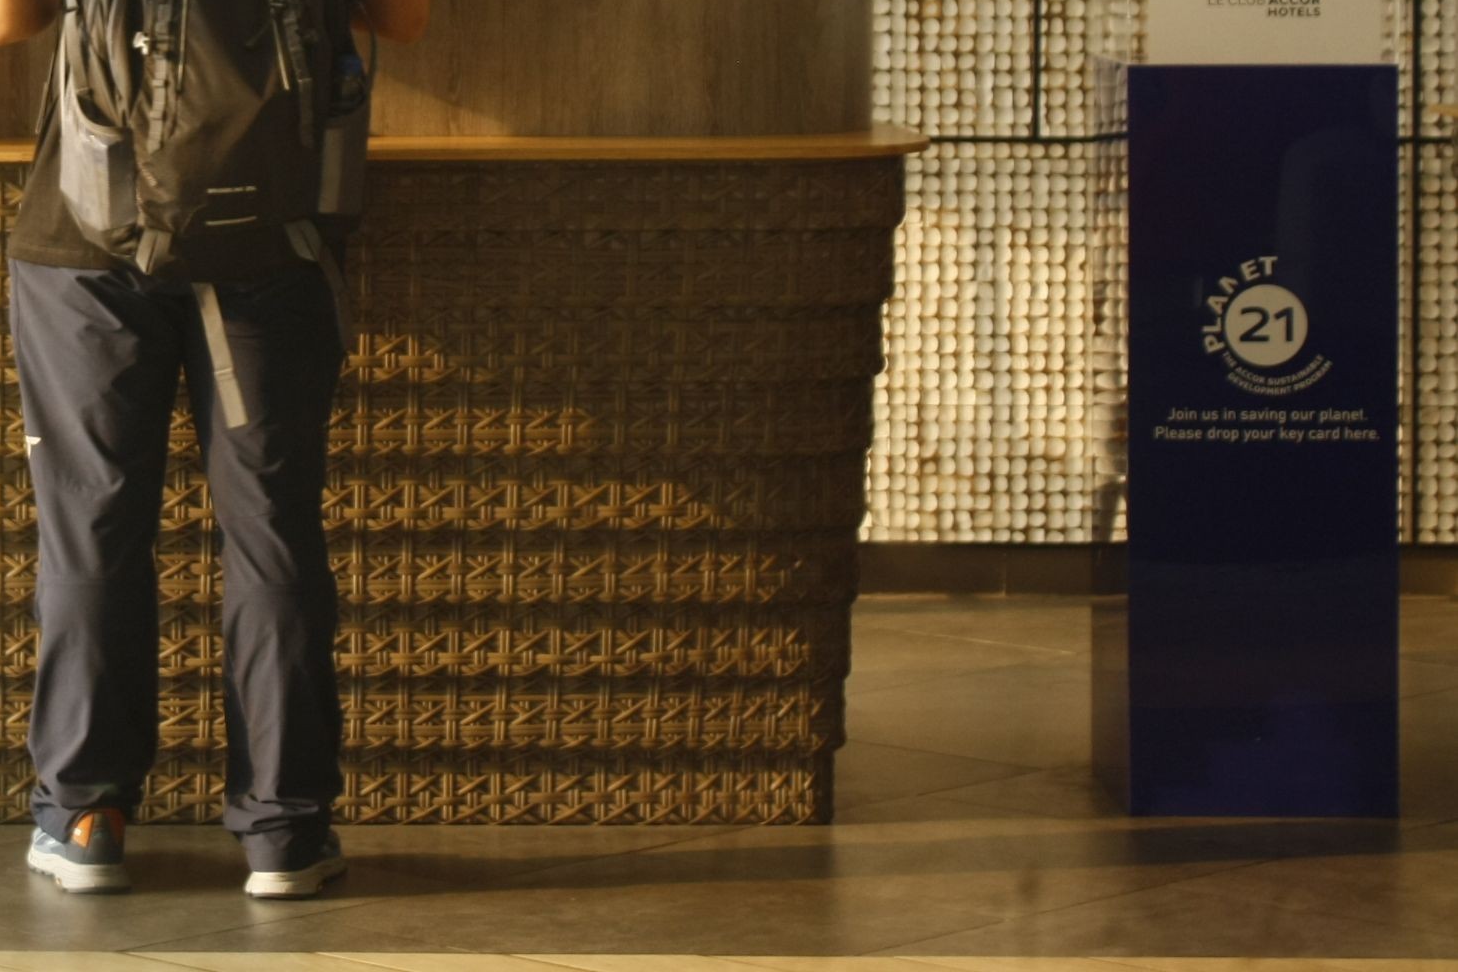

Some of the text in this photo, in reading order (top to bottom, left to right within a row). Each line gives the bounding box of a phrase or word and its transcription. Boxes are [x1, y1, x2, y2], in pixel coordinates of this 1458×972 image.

[1267, 6, 1321, 17] HOTELS
[1238, 306, 1295, 343] 21
[1167, 407, 1368, 424] Join us in saving our planet.
[1154, 426, 1380, 443] Please drop your key card here.
